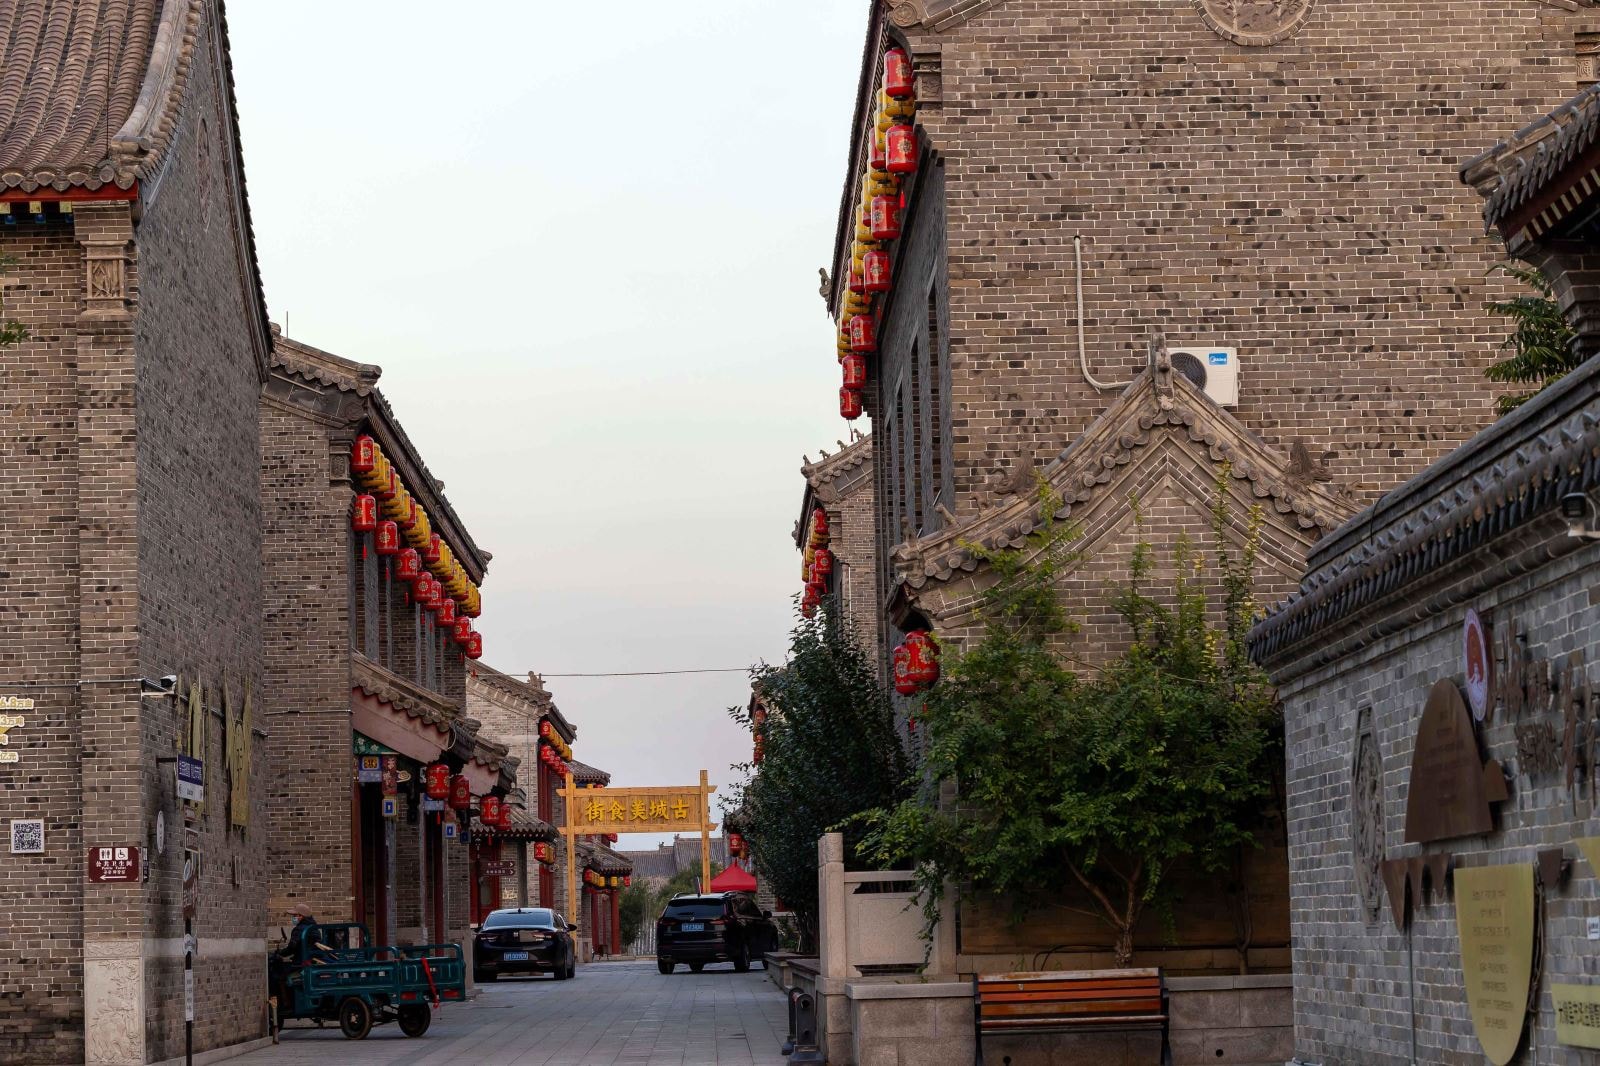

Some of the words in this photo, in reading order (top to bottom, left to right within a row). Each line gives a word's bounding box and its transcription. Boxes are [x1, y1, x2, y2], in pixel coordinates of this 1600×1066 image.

[585, 799, 689, 822] 古城美食街
